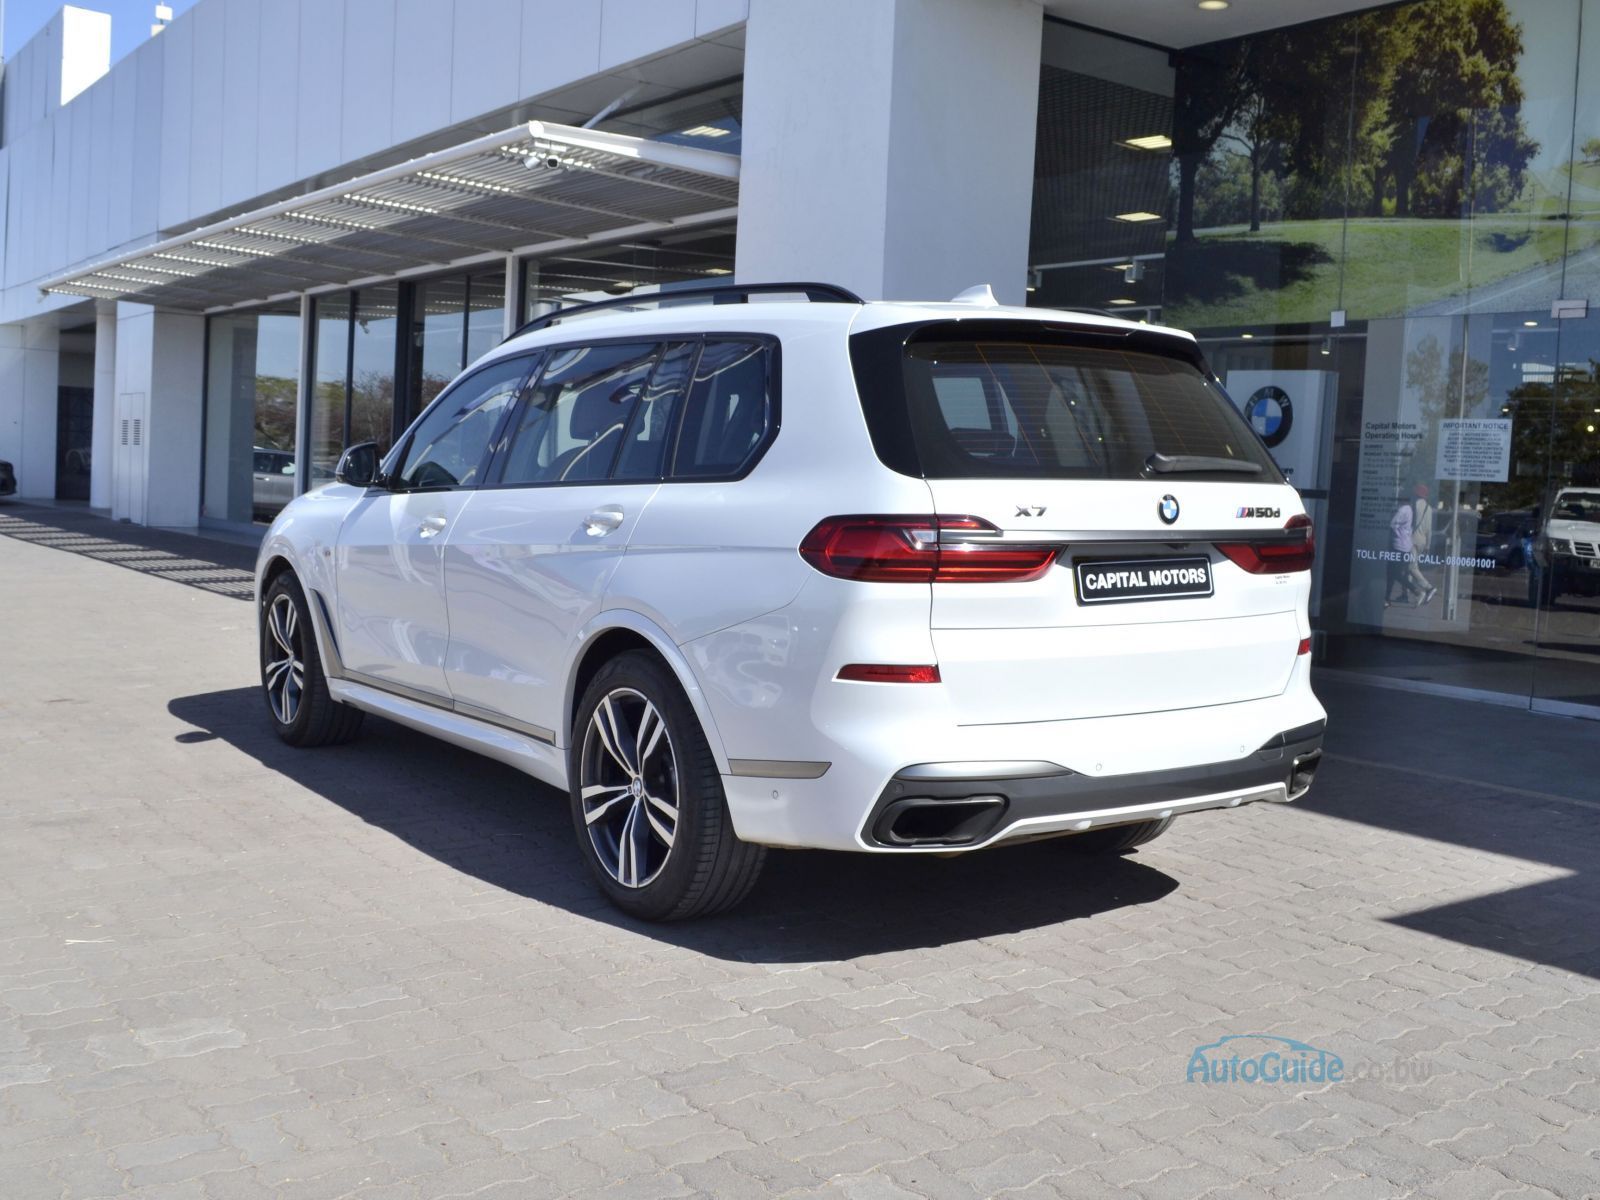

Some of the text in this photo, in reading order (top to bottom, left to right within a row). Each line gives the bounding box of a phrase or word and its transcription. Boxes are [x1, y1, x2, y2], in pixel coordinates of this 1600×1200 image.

[1365, 422, 1417, 430] Capital Motors
[1364, 431, 1423, 440] Operating Hours
[1014, 504, 1048, 517] X7
[1356, 549, 1378, 560] TOLL
[1379, 551, 1402, 562] FREE
[1403, 552, 1416, 563] ON
[1446, 556, 1496, 568] 0800601001
[1085, 568, 1207, 590] CAPITAL MOTORS
